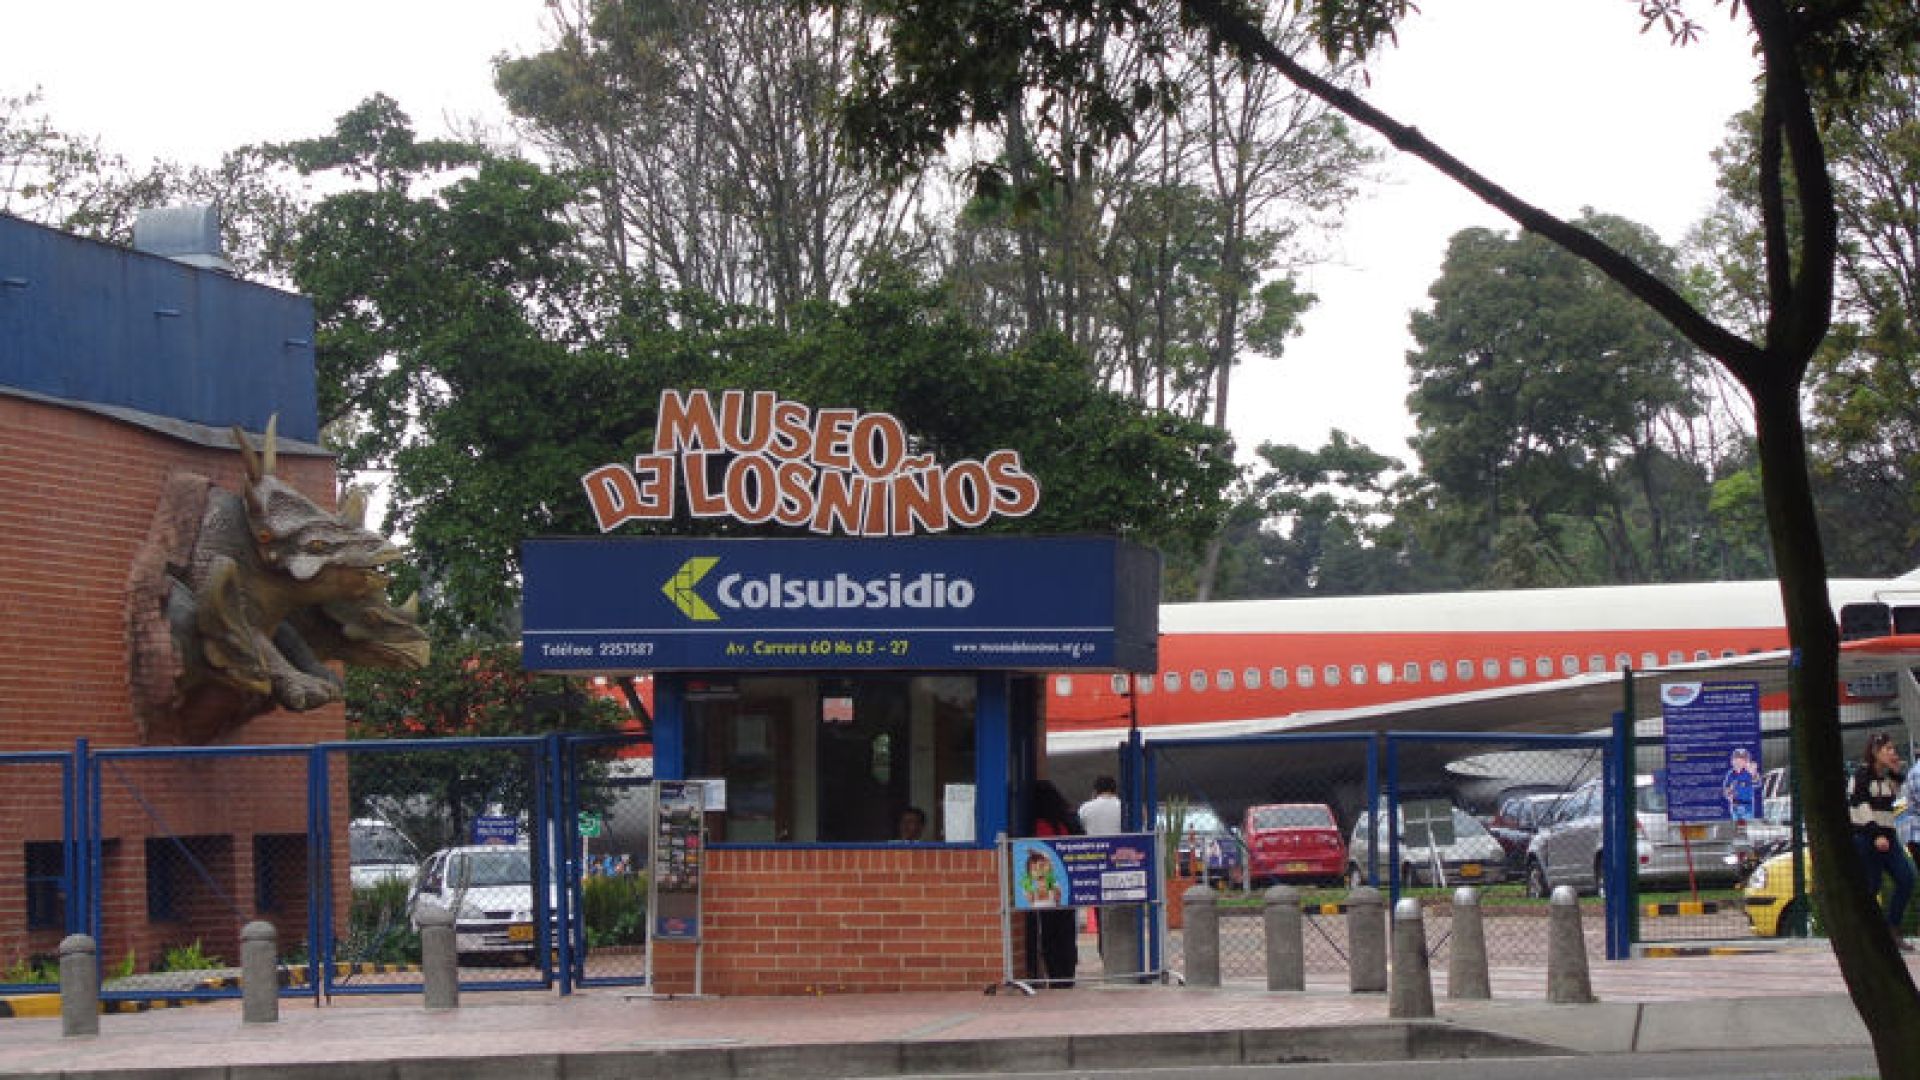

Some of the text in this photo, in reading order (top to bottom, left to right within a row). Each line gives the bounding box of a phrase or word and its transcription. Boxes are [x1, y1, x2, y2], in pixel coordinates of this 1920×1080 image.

[654, 388, 906, 478] MUSEO
[717, 573, 976, 608] Colsubsidio
[725, 641, 750, 656] Av.
[753, 640, 807, 655] Carrera
[810, 640, 831, 655] 60
[890, 640, 909, 656] 27
